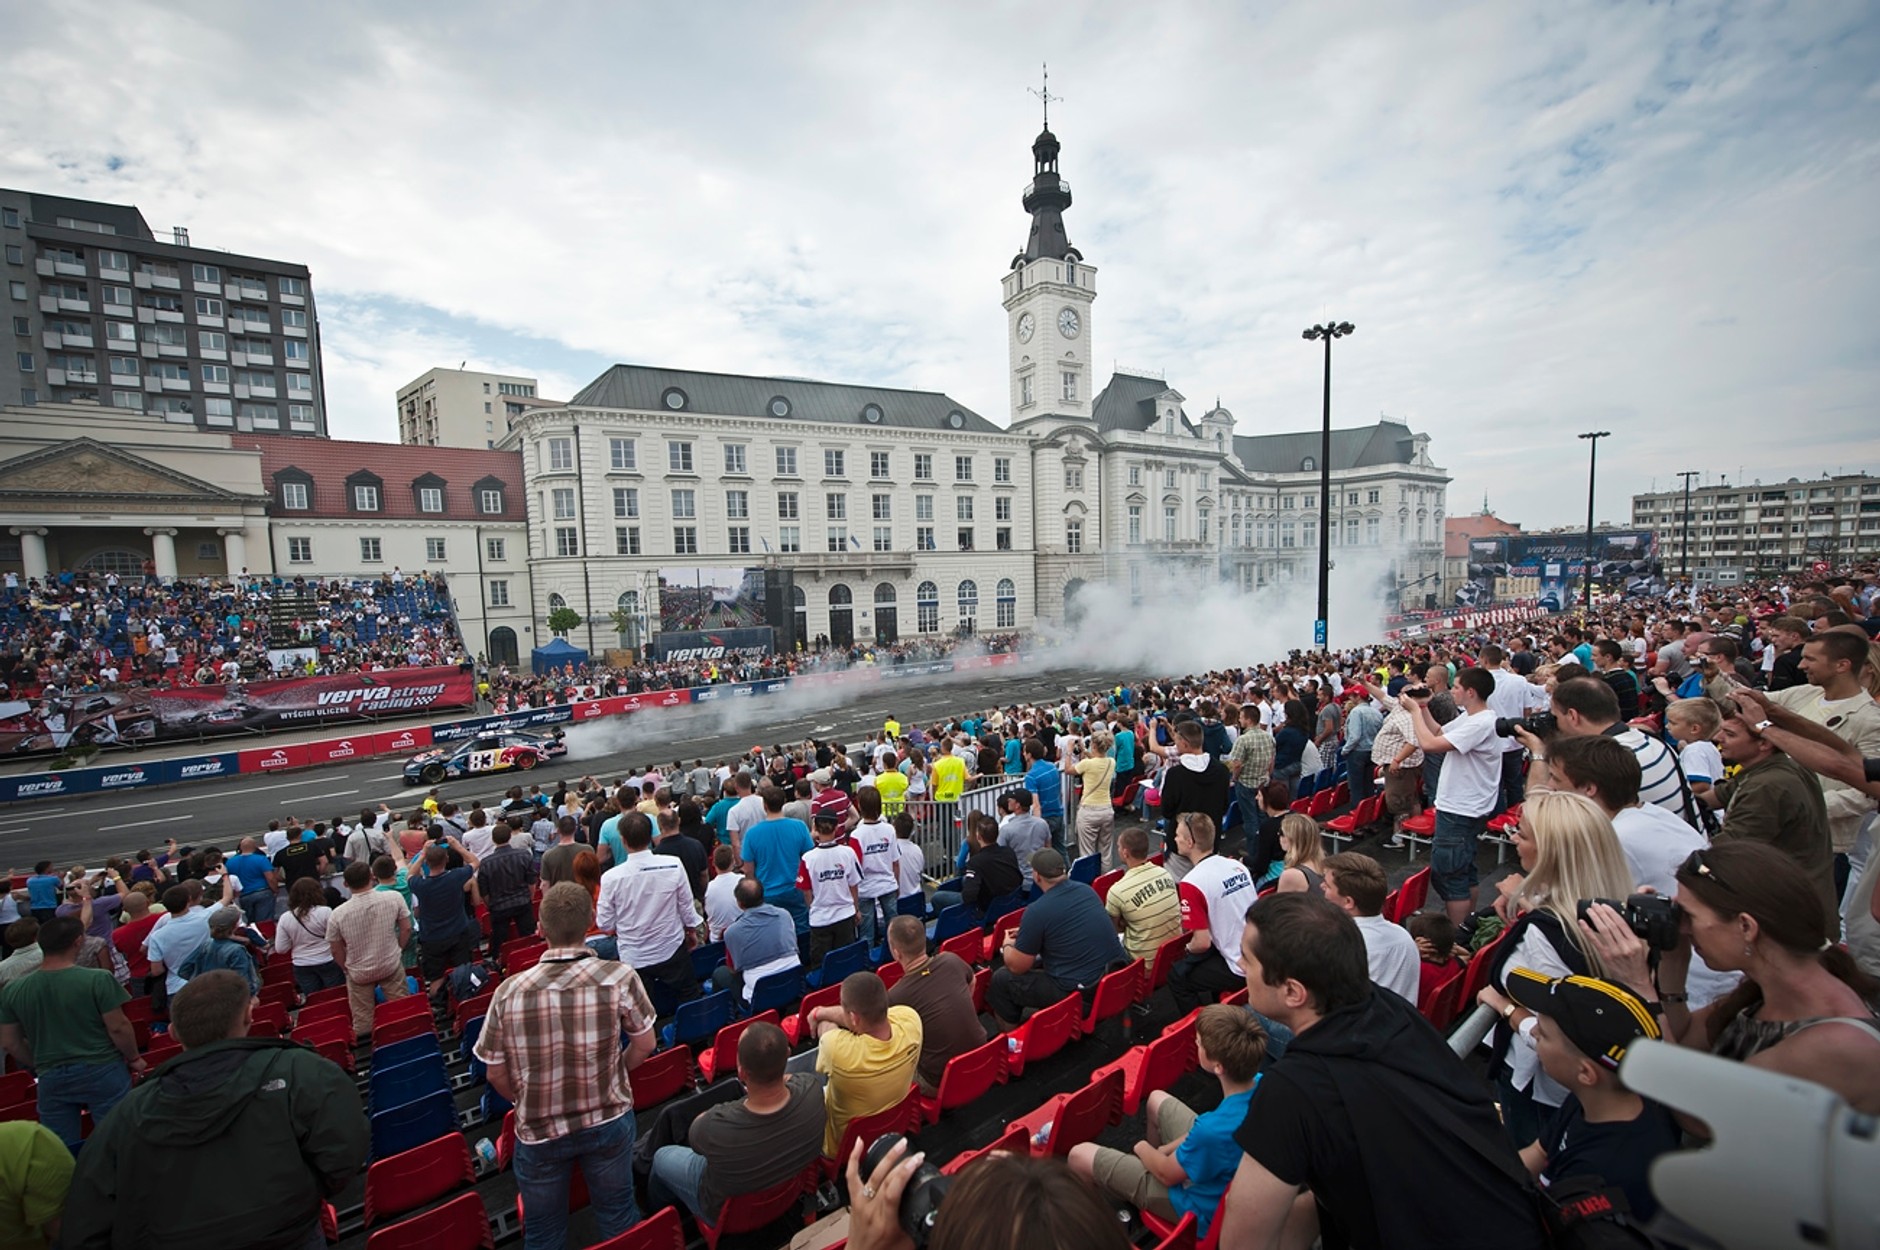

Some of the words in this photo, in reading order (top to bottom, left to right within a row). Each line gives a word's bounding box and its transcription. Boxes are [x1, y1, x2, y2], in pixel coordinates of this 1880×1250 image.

[1567, 565, 1599, 575] STAT
[1316, 621, 1323, 630] P
[1317, 634, 1323, 643] P
[666, 646, 725, 662] verva
[317, 685, 392, 705] verva
[391, 683, 446, 699] street
[357, 695, 415, 712] racing
[280, 709, 315, 720] WYŚCIGI
[316, 706, 349, 716] ULICZNE
[182, 762, 222, 773] verva
[469, 751, 495, 772] 83
[102, 771, 144, 782] verva
[18, 780, 63, 792] verva
[1222, 872, 1248, 890] verva
[1131, 883, 1156, 908] UPPER
